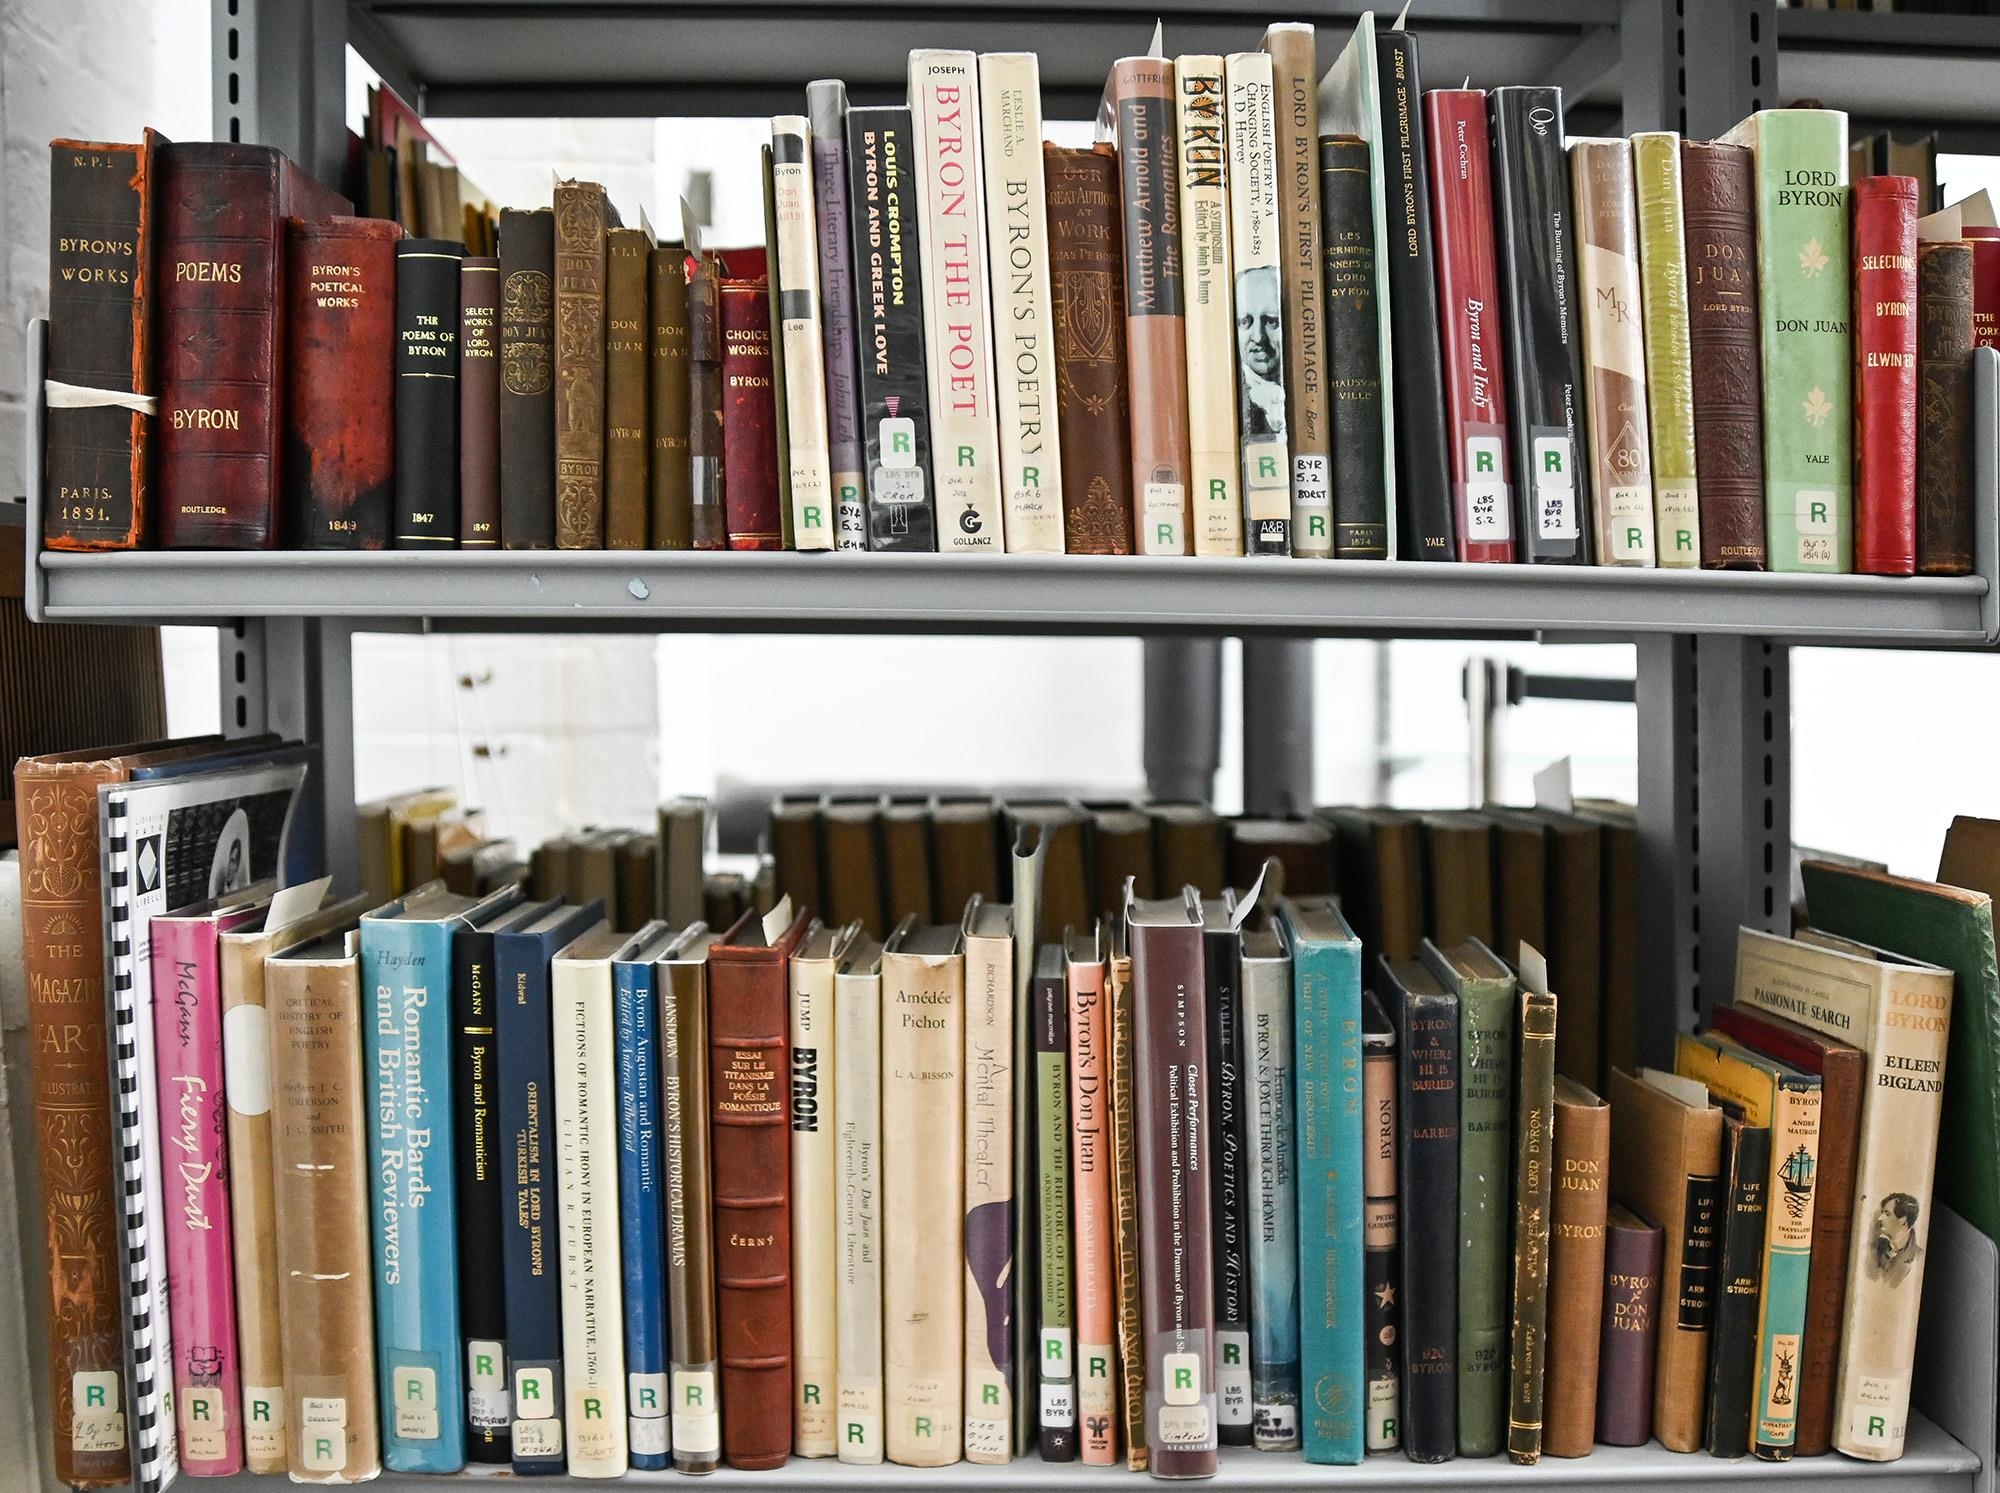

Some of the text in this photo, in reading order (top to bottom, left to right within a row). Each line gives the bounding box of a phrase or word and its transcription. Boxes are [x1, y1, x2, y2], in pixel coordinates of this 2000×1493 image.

[928, 65, 965, 75] JOSEPH
[1394, 49, 1405, 80] BORST
[1001, 90, 1014, 157] MARCHAND
[1457, 120, 1468, 179] Peter Cochran
[1397, 87, 1418, 257] LORD BYRON'S FIRST PILGRIMAGE
[1785, 171, 1836, 186] LORD
[1129, 105, 1156, 309] Matthew Arnold and
[1161, 136, 1179, 277] The Romantics
[1778, 191, 1841, 207] BYRON
[884, 131, 905, 305] LOUIS CROMPTON
[1058, 221, 1111, 240] WORK
[60, 238, 132, 256] BYRON'S
[864, 131, 888, 376] BYRON AND GREEK LOVE
[935, 84, 977, 417] BYRON THE POET
[1293, 78, 1318, 441] LORD BYRON'S FIRST PILGRIMAGE Borst
[62, 268, 128, 283] WORKS
[176, 262, 241, 283] POEMS
[312, 266, 360, 276] BYRON'S
[311, 282, 366, 293] POETICAL
[317, 298, 358, 308] WORKS
[611, 320, 638, 329] DON
[788, 322, 804, 331] Lee
[1006, 178, 1043, 456] BYRON'S POETRY
[1776, 320, 1847, 334] DON JUAN
[403, 331, 454, 341] POEMS OF
[726, 329, 768, 341] CHOICE
[409, 346, 446, 356] BYRON
[728, 345, 769, 355] WORKS
[1466, 298, 1490, 408] Byron and Italy
[729, 376, 769, 386] BYRON
[173, 410, 239, 429] BYRON
[893, 432, 911, 453] R
[958, 446, 975, 467] R
[1297, 460, 1323, 469] BYR
[1477, 451, 1493, 472] R
[1545, 451, 1562, 472] R
[1806, 455, 1829, 464] YALE
[1022, 466, 1040, 488] R
[1258, 456, 1277, 478] R
[1296, 473, 1320, 482] 5.2
[61, 488, 112, 499] PARIS.
[1210, 479, 1226, 500] R
[182, 505, 226, 514] ROUTLEDGE
[412, 513, 434, 522] 1847
[803, 506, 822, 528] R
[1811, 502, 1827, 523] R
[1158, 524, 1174, 544] R
[1260, 521, 1284, 533] A&B
[1309, 515, 1326, 537] R
[953, 536, 992, 546] GOLLANCZ
[1425, 538, 1445, 546] YALE
[1627, 528, 1643, 548] R
[1676, 530, 1692, 550] R
[46, 945, 83, 958] THE
[984, 963, 996, 1026] RICHARDSON
[1892, 990, 1947, 1010] LORD
[797, 991, 811, 1031] JUMP
[1177, 985, 1185, 1047] SIMPSON
[1755, 988, 1807, 1015] PASSIONATE
[1811, 1006, 1850, 1030] SEARCH
[576, 1001, 586, 1058] FICTIONS
[902, 1013, 946, 1029] Pichot
[1885, 1013, 1946, 1033] BYRON
[577, 1062, 586, 1077] OF
[732, 1061, 766, 1070] SUR LE
[1885, 1055, 1940, 1073] EILEEN
[723, 1071, 775, 1080] TITANISME
[1073, 990, 1100, 1173] Byron's Don Juan
[1412, 1080, 1455, 1091] BURIED
[1878, 1074, 1942, 1093] BIGLAND
[634, 988, 653, 1193] Byron: Augustan and Romantic
[729, 1082, 769, 1090] DANS LA
[793, 1047, 818, 1133] BYRON
[403, 985, 432, 1208] Romantic Bards
[719, 1101, 781, 1112] ROMANTIQUE
[1789, 1097, 1820, 1106] BYRON
[472, 1046, 489, 1181] Byron and Romanticism
[577, 1082, 590, 1145] ROMANTIC
[1186, 1065, 1199, 1171] Closet Performances
[377, 985, 404, 1286] and British Reviewers
[665, 995, 685, 1267] LANSDOWN BYRON'S HISTORICAL DRAMAS
[1380, 1099, 1392, 1160] BYRON
[1529, 1108, 1541, 1153] BYRON
[579, 1150, 591, 1187] IRONY
[1528, 1160, 1539, 1194] LORD
[1566, 1160, 1599, 1174] DON
[1562, 1177, 1601, 1192] JUAN
[1743, 1183, 1760, 1192] LIFE
[581, 1190, 592, 1205] IN
[1746, 1194, 1755, 1202] OF
[1737, 1204, 1761, 1212] BYRON
[1555, 1224, 1603, 1239] BYRON
[582, 1211, 593, 1273] EUROPEAN
[1615, 1302, 1647, 1316] DON
[476, 1355, 493, 1376] R
[86, 1386, 106, 1407] R
[522, 1379, 540, 1399] R
[640, 1388, 656, 1408] R
[686, 1386, 702, 1406] R
[804, 1385, 820, 1404] R
[192, 1399, 209, 1421] R
[253, 1400, 270, 1422] R
[584, 1399, 603, 1419] R
[316, 1438, 333, 1459] R
